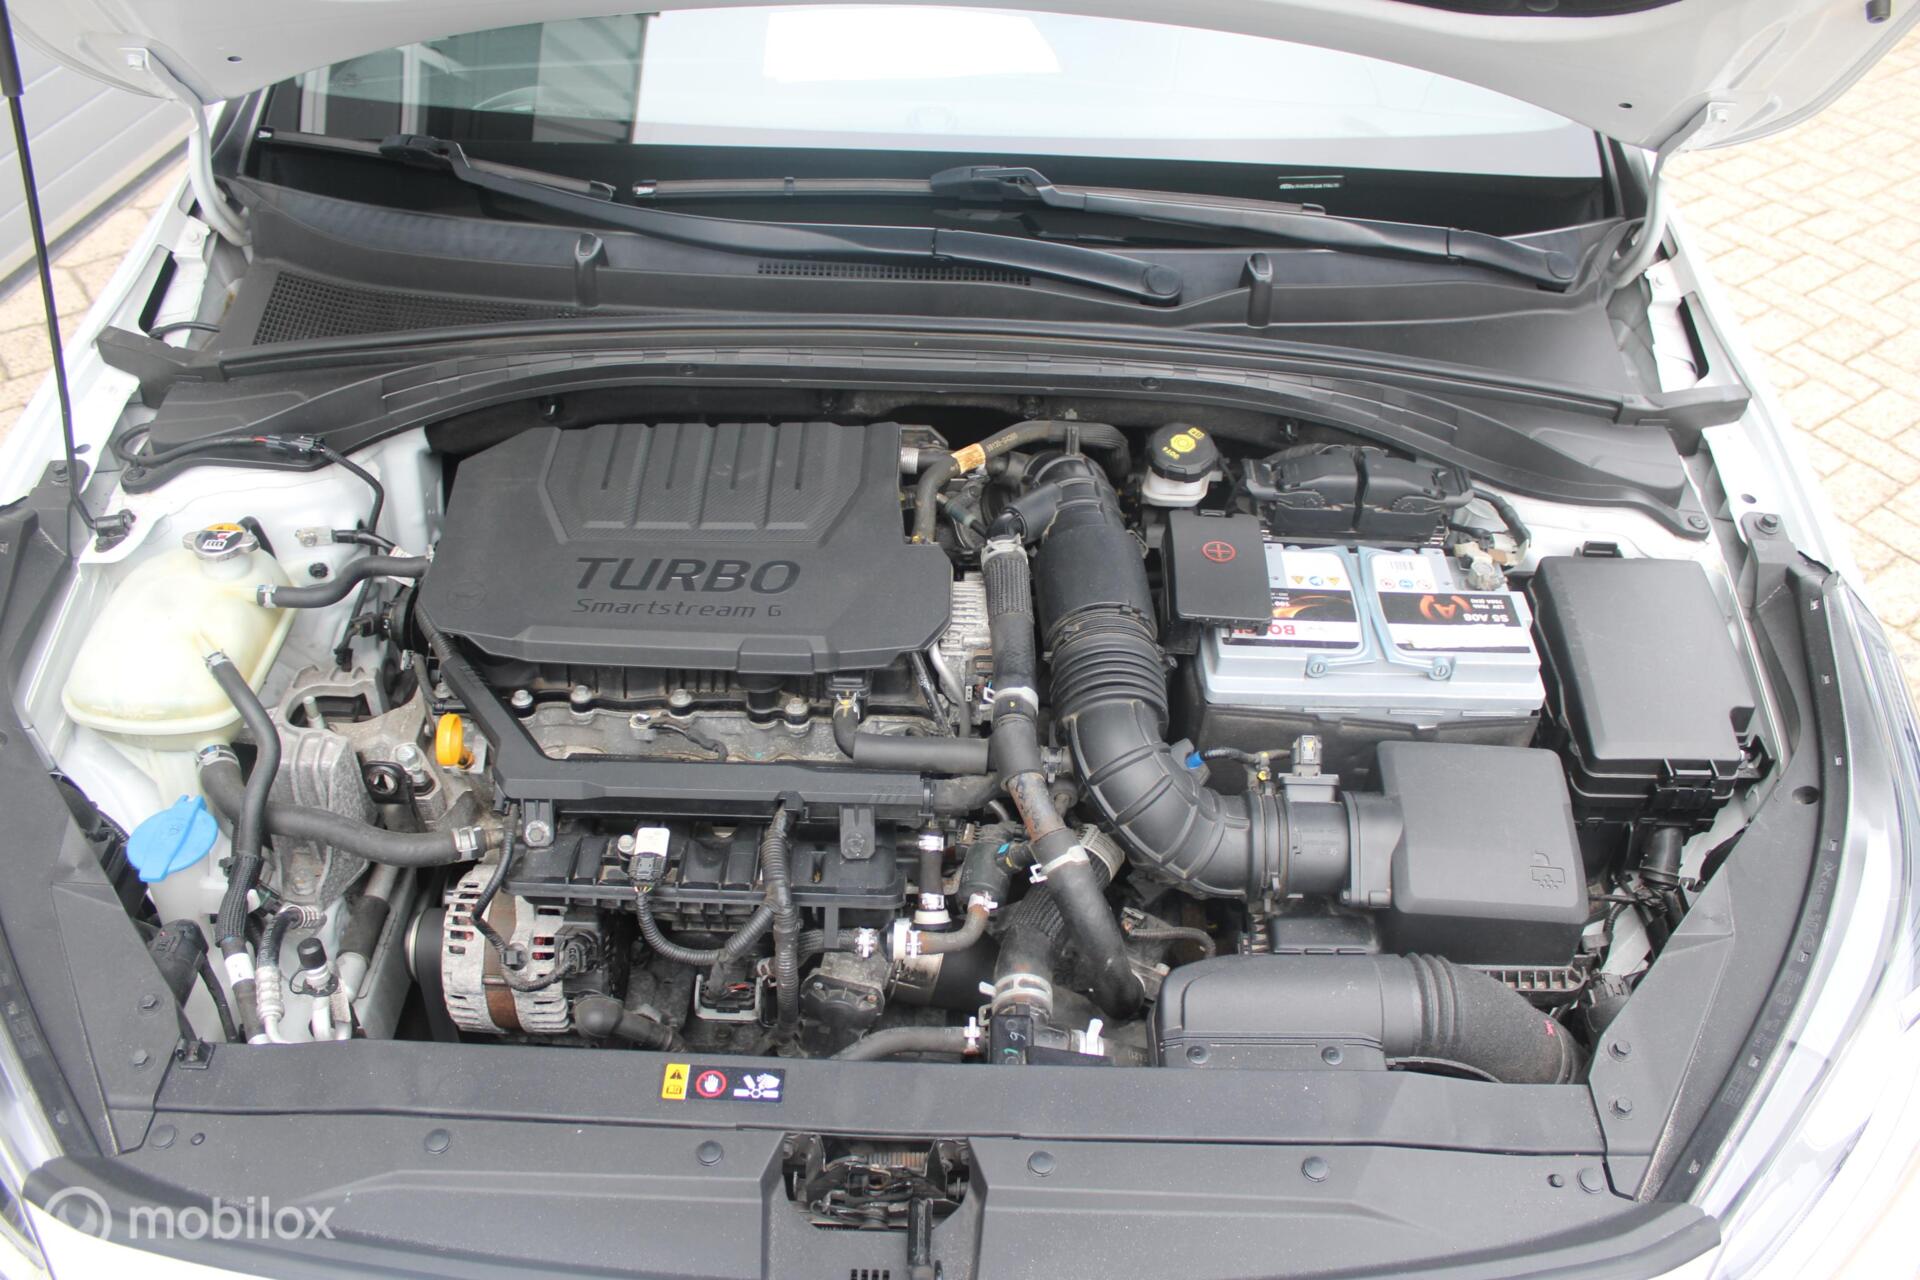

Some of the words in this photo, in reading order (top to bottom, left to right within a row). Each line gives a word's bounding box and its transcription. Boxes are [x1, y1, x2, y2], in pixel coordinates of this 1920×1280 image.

[576, 557, 800, 594] TURBO
[572, 598, 756, 618] Smartstream
[768, 604, 782, 617] G
